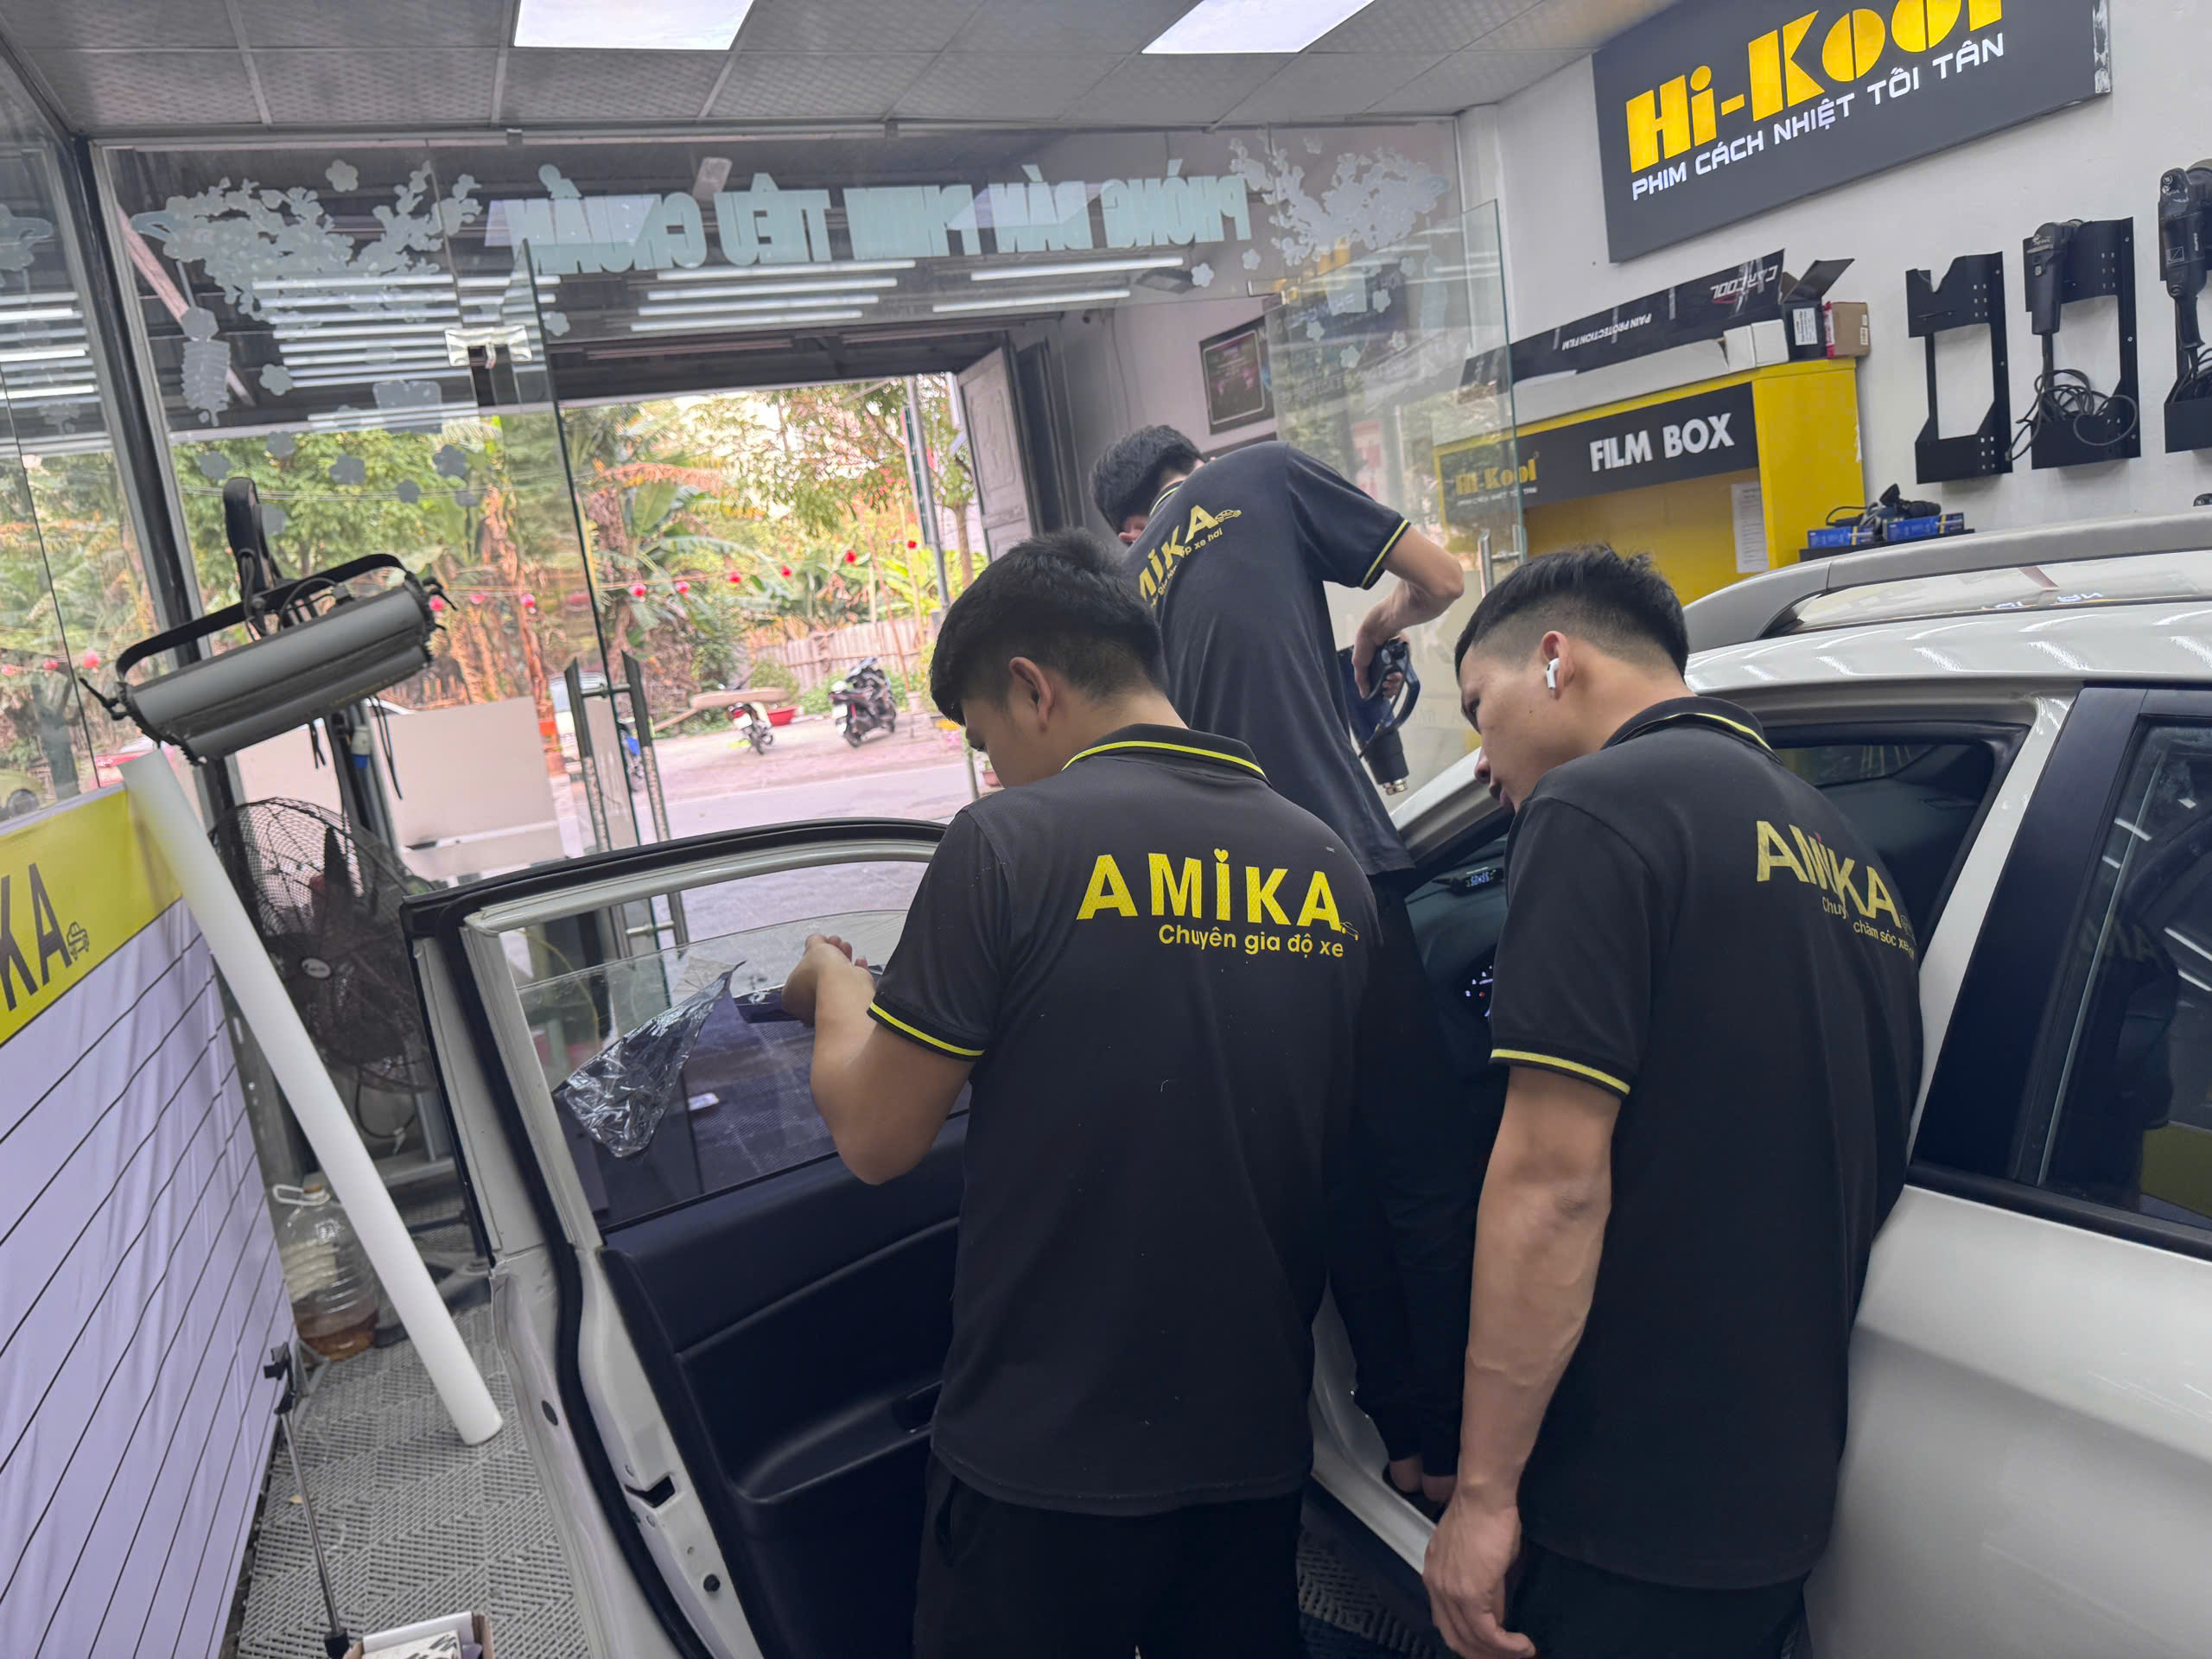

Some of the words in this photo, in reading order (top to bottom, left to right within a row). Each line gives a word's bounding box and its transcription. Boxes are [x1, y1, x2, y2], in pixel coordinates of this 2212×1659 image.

[1632, 162, 1688, 200] PHIM
[1695, 130, 1764, 175] CÁCH
[1774, 92, 1855, 145] NHIỆT
[1932, 32, 2005, 80] TÂN
[1561, 336, 1580, 351] FILM
[1579, 320, 1630, 345] PROTECTION
[1590, 430, 1652, 473] FILM
[1662, 413, 1735, 460] BOX
[1158, 924, 1236, 950] Chuyên
[1244, 931, 1281, 955] gia
[1287, 933, 1313, 959] độ
[1319, 939, 1344, 958] xe
[1879, 929, 1897, 947] sóc
